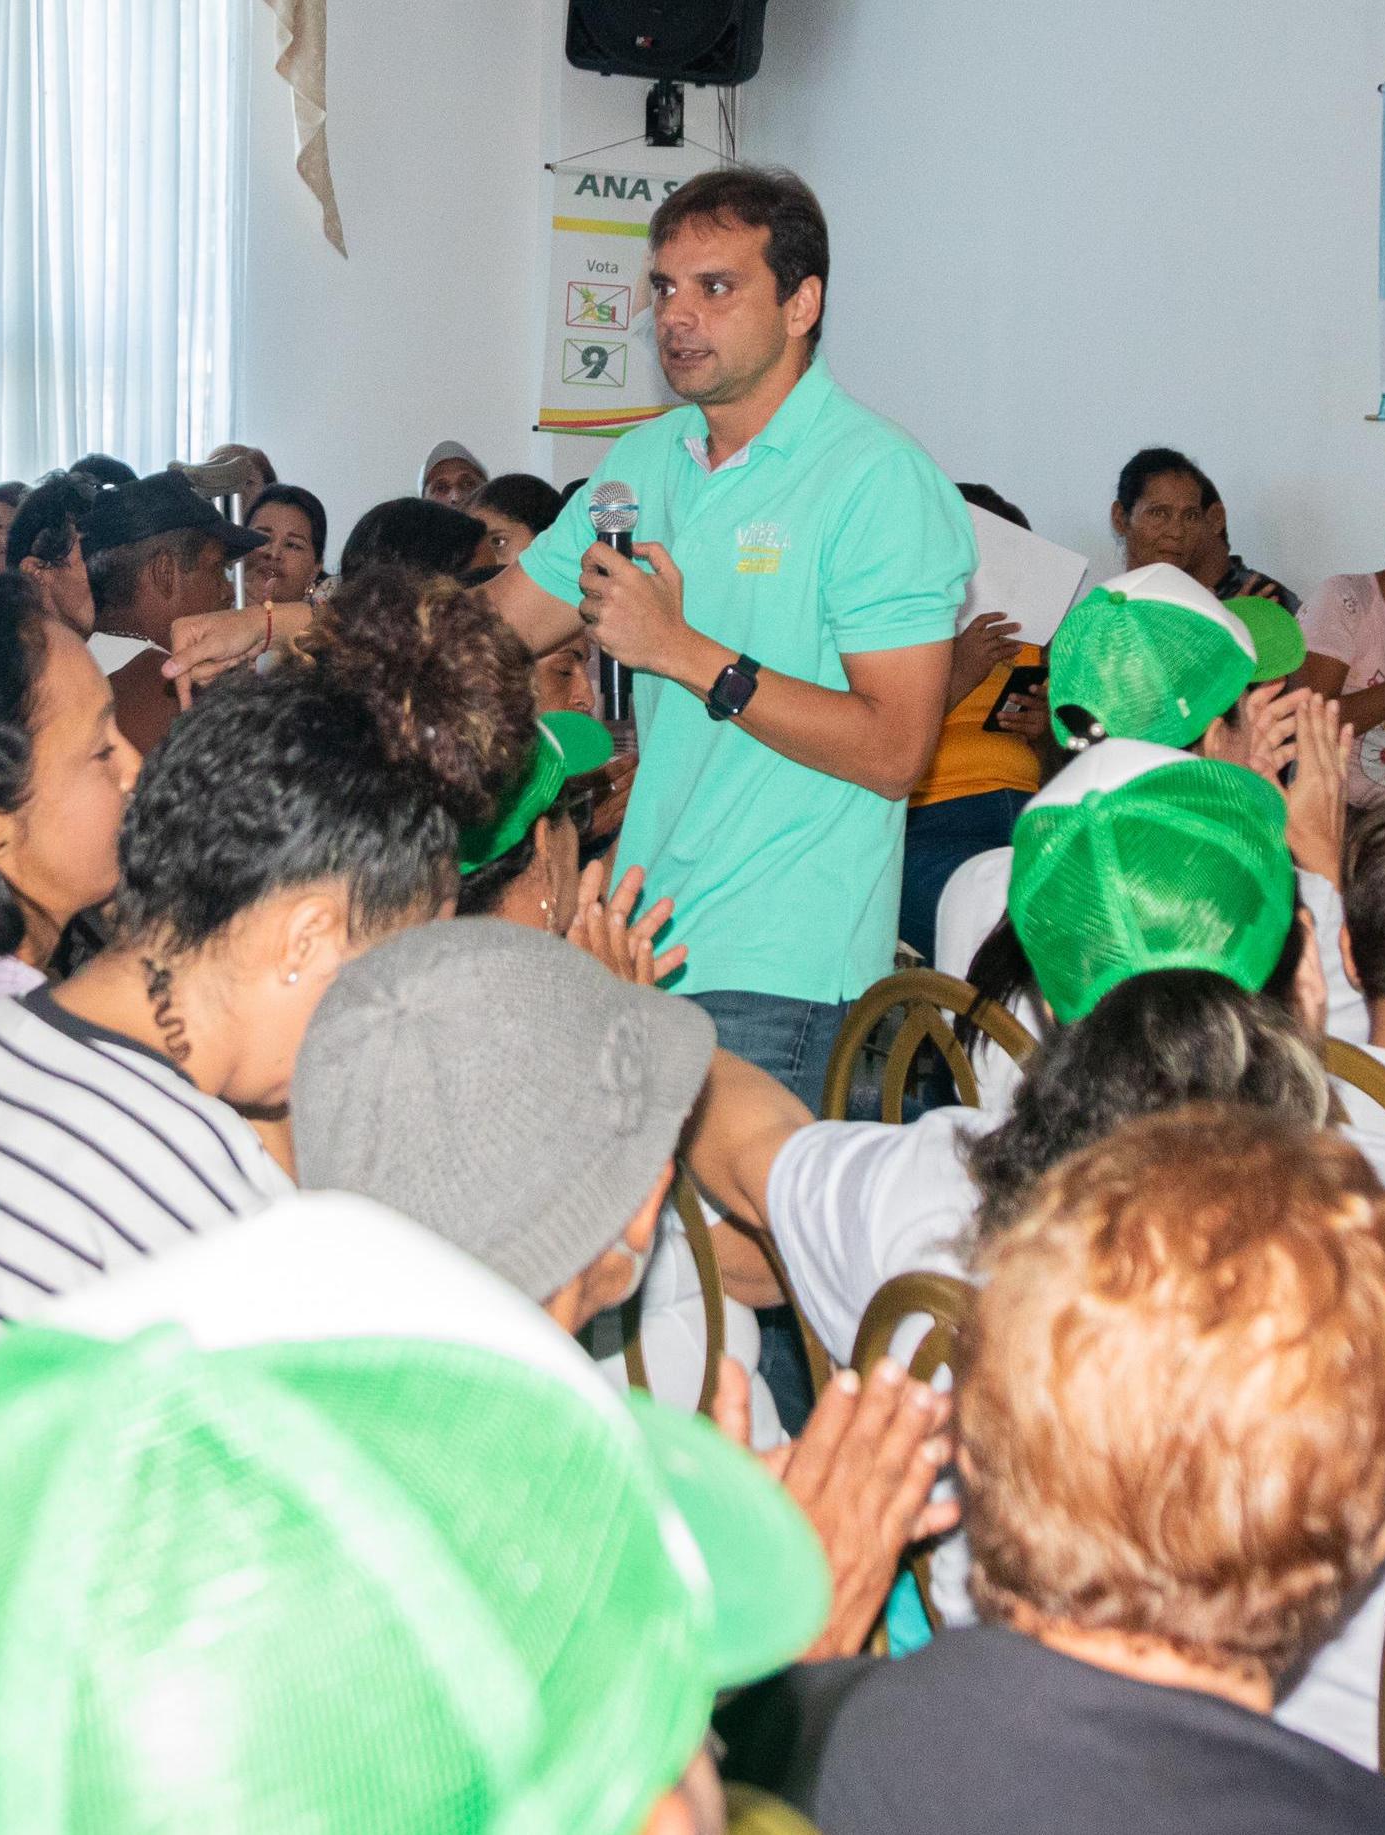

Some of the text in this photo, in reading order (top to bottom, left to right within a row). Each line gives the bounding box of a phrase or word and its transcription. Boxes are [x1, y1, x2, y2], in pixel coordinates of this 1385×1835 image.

[574, 174, 652, 201] ANA
[586, 259, 619, 274] Vota
[581, 345, 608, 379] 9
